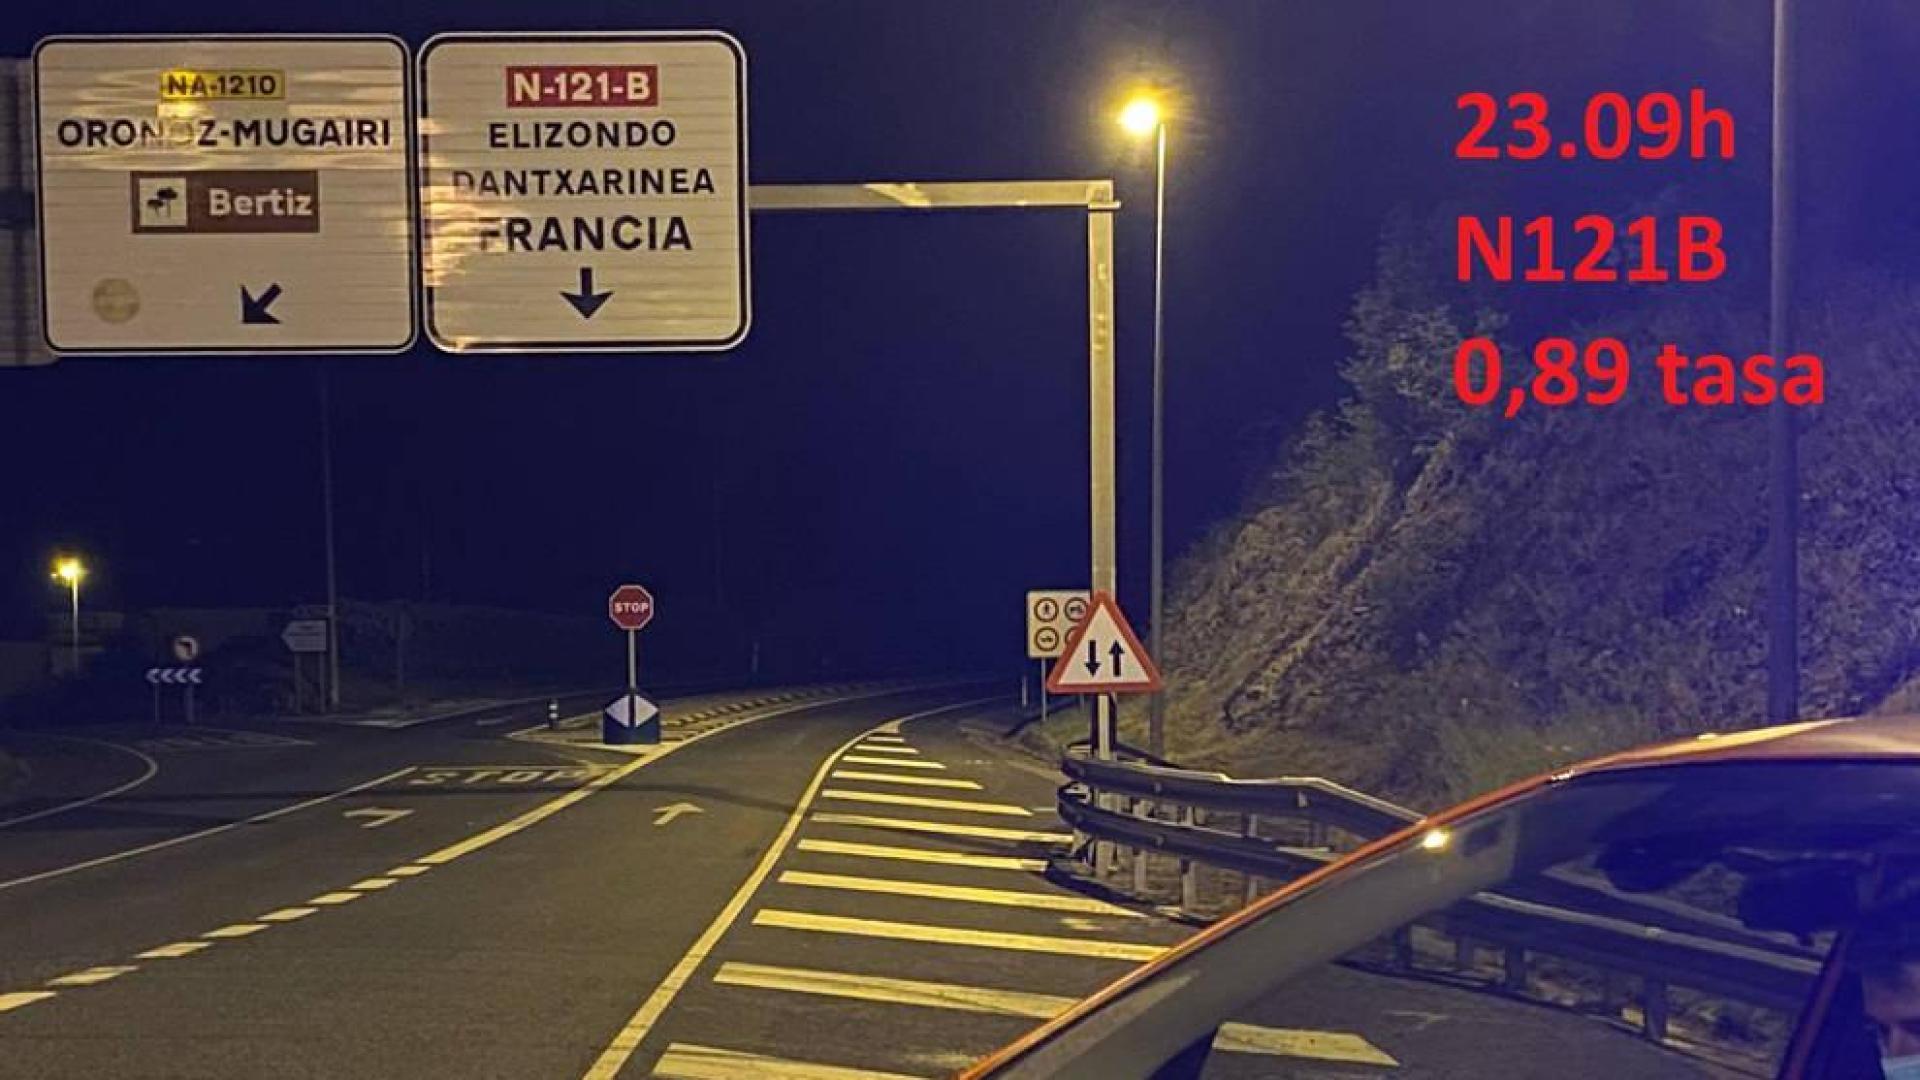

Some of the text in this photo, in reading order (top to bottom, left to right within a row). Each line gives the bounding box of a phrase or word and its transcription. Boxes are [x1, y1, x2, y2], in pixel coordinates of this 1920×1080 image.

[166, 75, 276, 97] NA-1210
[513, 72, 650, 102] N-121-B
[488, 120, 676, 148] ELIZONDO
[453, 167, 715, 195] DANTXARINEA
[208, 187, 313, 218] Bertiz
[480, 216, 693, 251] FRANCIA
[613, 601, 650, 614] STOP
[408, 769, 589, 786] STOP
